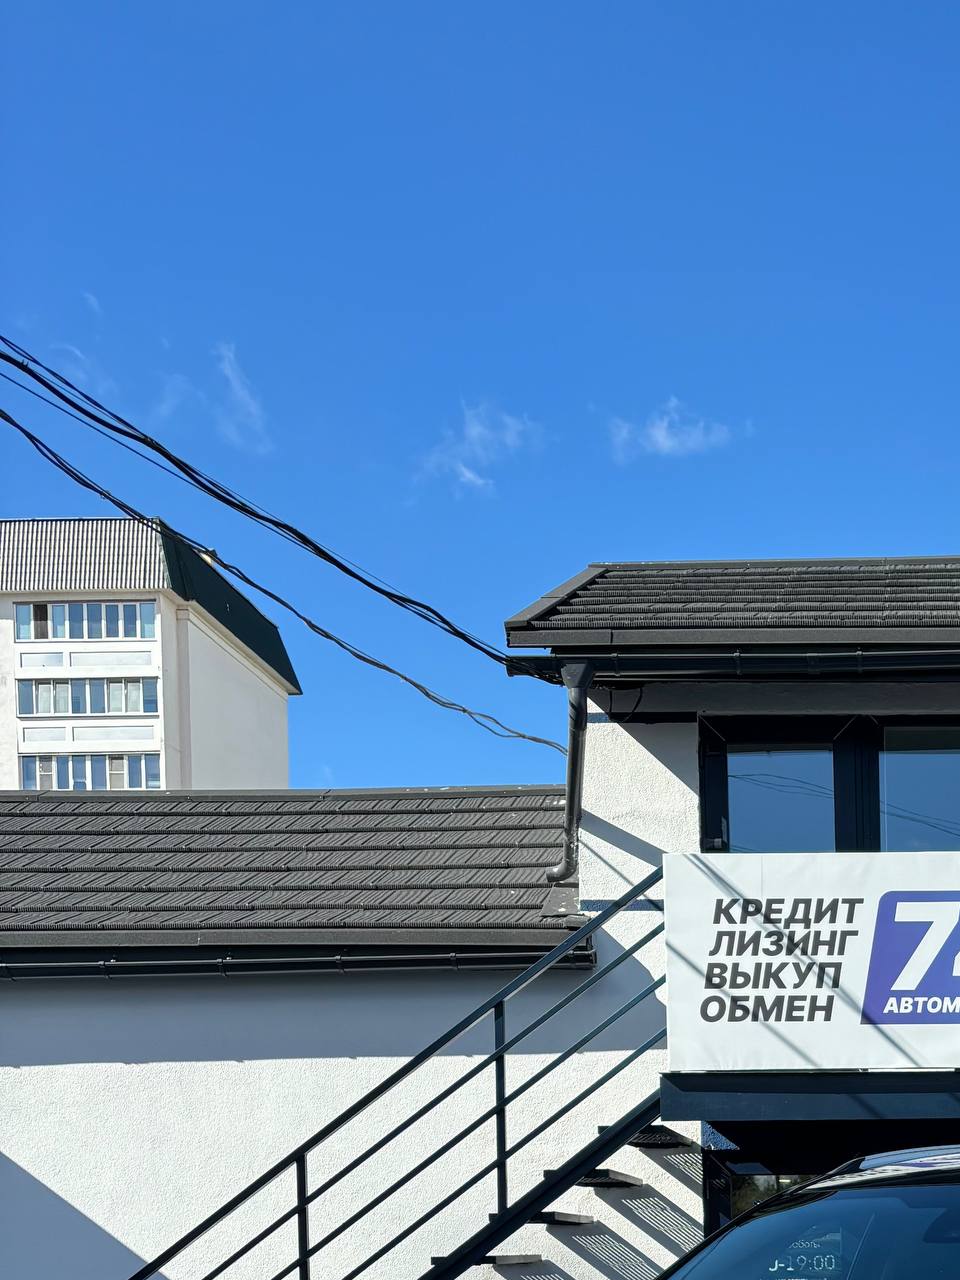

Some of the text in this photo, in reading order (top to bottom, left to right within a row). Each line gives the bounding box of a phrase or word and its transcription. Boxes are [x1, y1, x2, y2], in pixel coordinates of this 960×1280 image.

[713, 897, 864, 929] КРЕДИТ
[708, 929, 859, 957] ЛИЗИНГ
[704, 962, 842, 990] ВЫКУП
[699, 995, 834, 1023] ОБМЕН
